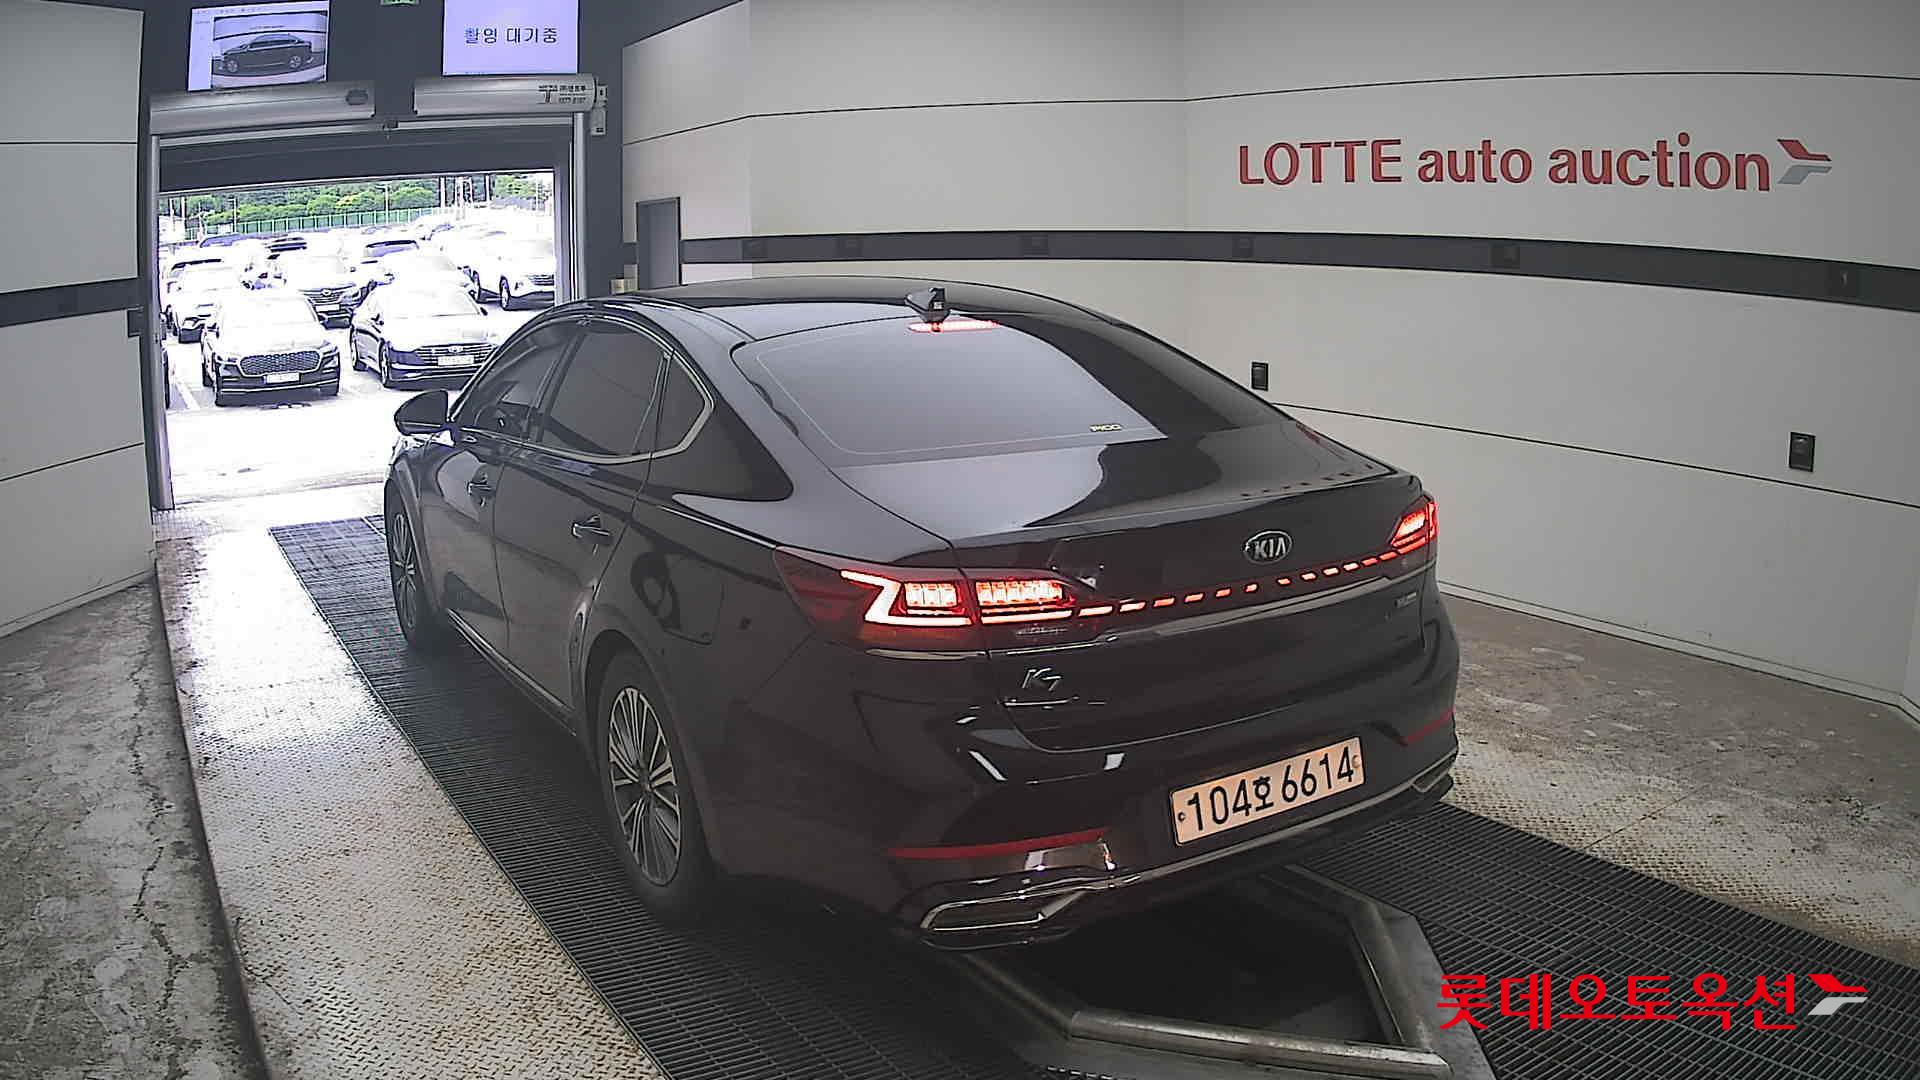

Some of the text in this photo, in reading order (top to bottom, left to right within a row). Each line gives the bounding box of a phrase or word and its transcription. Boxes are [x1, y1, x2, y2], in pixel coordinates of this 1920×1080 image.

[506, 27, 557, 44] 대기중
[1239, 132, 1771, 192] LOTTE auto auction
[1254, 537, 1286, 560] KIA
[1021, 667, 1062, 692] K7
[1187, 746, 1354, 831] 104호 6614
